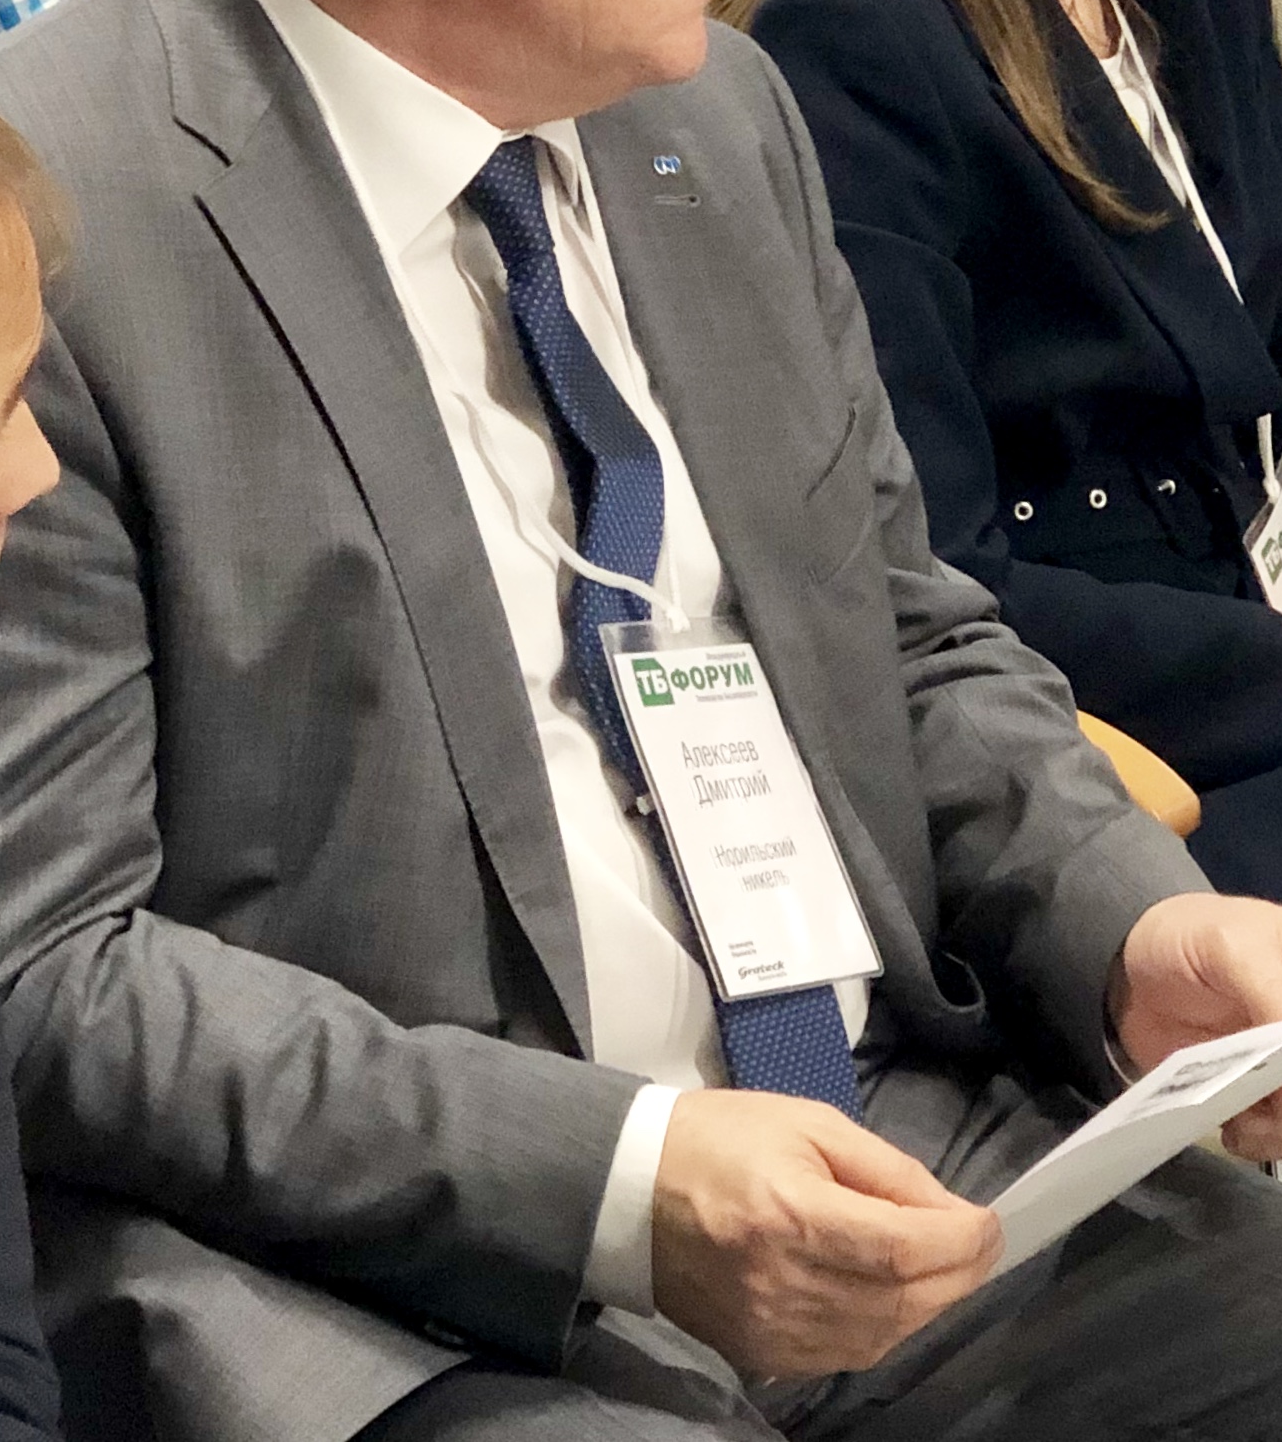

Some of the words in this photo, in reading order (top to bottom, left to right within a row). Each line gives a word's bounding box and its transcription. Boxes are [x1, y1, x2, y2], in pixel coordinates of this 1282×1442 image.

[635, 667, 669, 696] ТБ
[670, 661, 755, 691] ФОРУМ
[681, 740, 759, 769] Алексеев
[693, 769, 772, 808] Дмитрий
[713, 836, 797, 871] Норильский
[741, 869, 790, 892] никель
